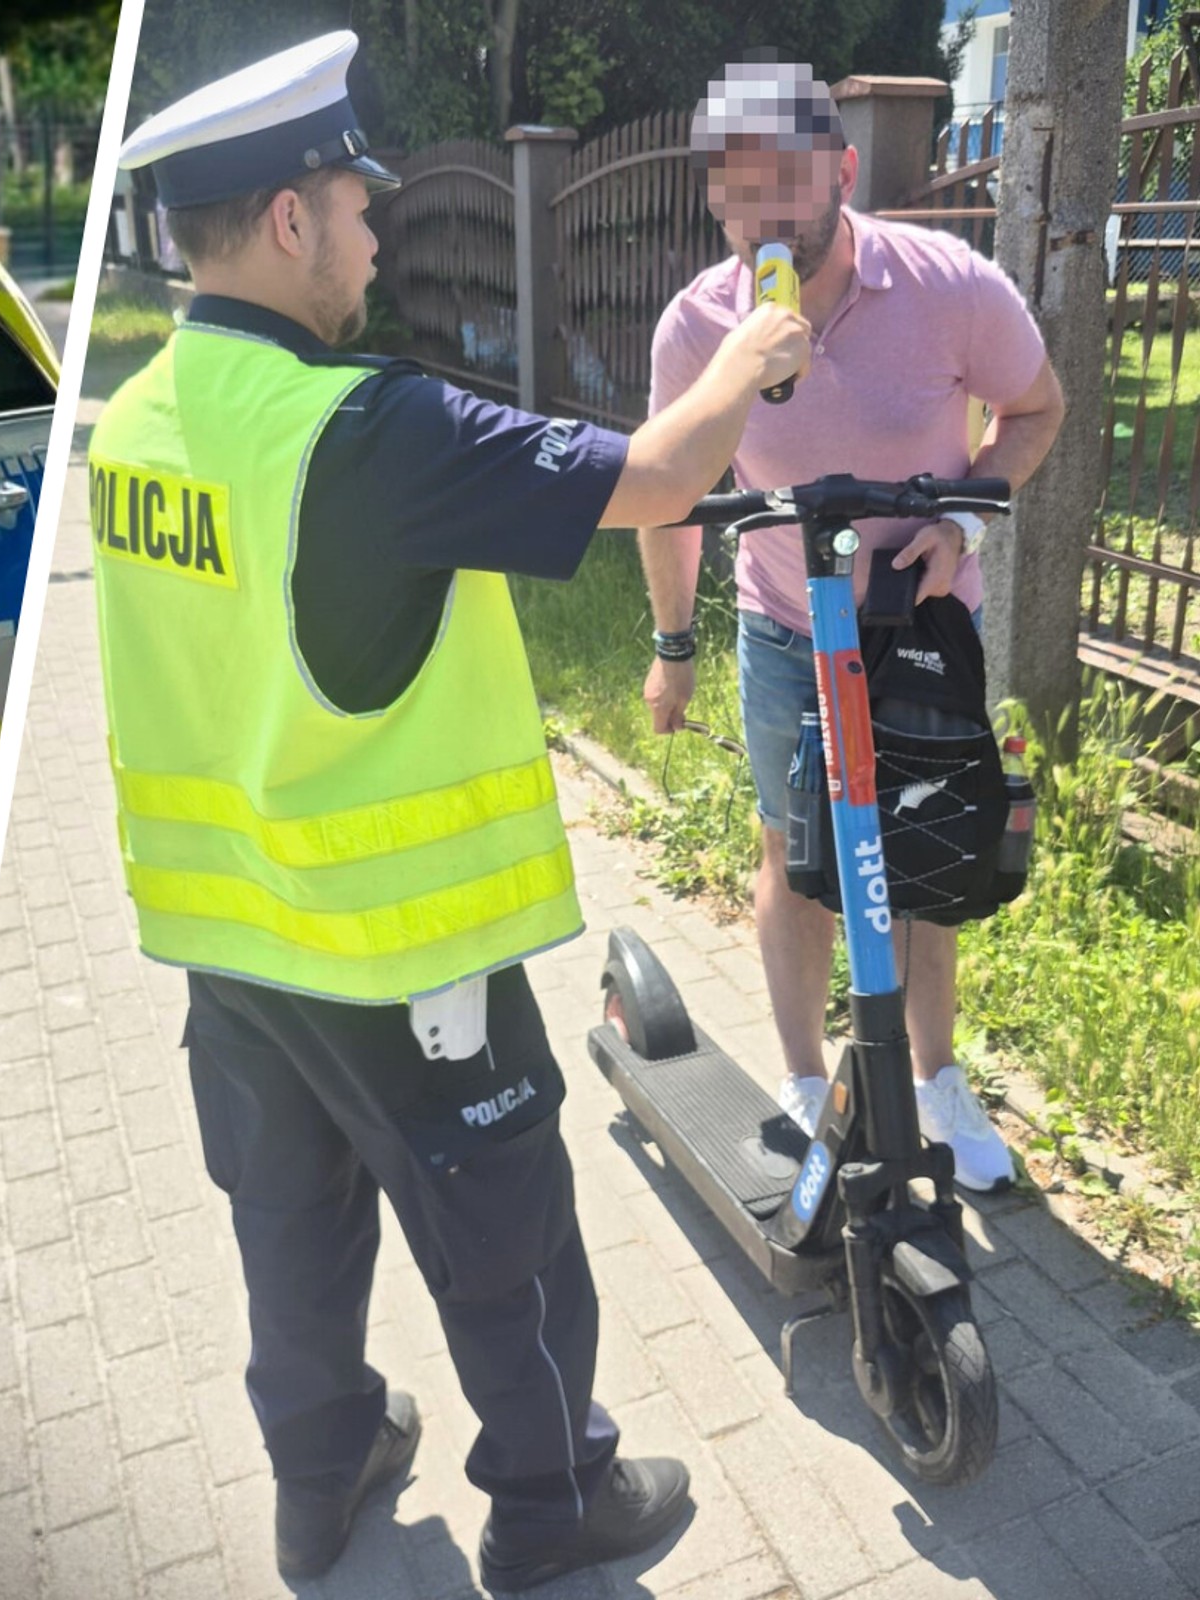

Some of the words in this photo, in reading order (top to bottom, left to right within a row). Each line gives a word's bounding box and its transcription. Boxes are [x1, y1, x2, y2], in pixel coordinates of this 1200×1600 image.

[854, 835, 892, 934] dott
[461, 1076, 537, 1127] POLICJA
[799, 1153, 826, 1210] dott
